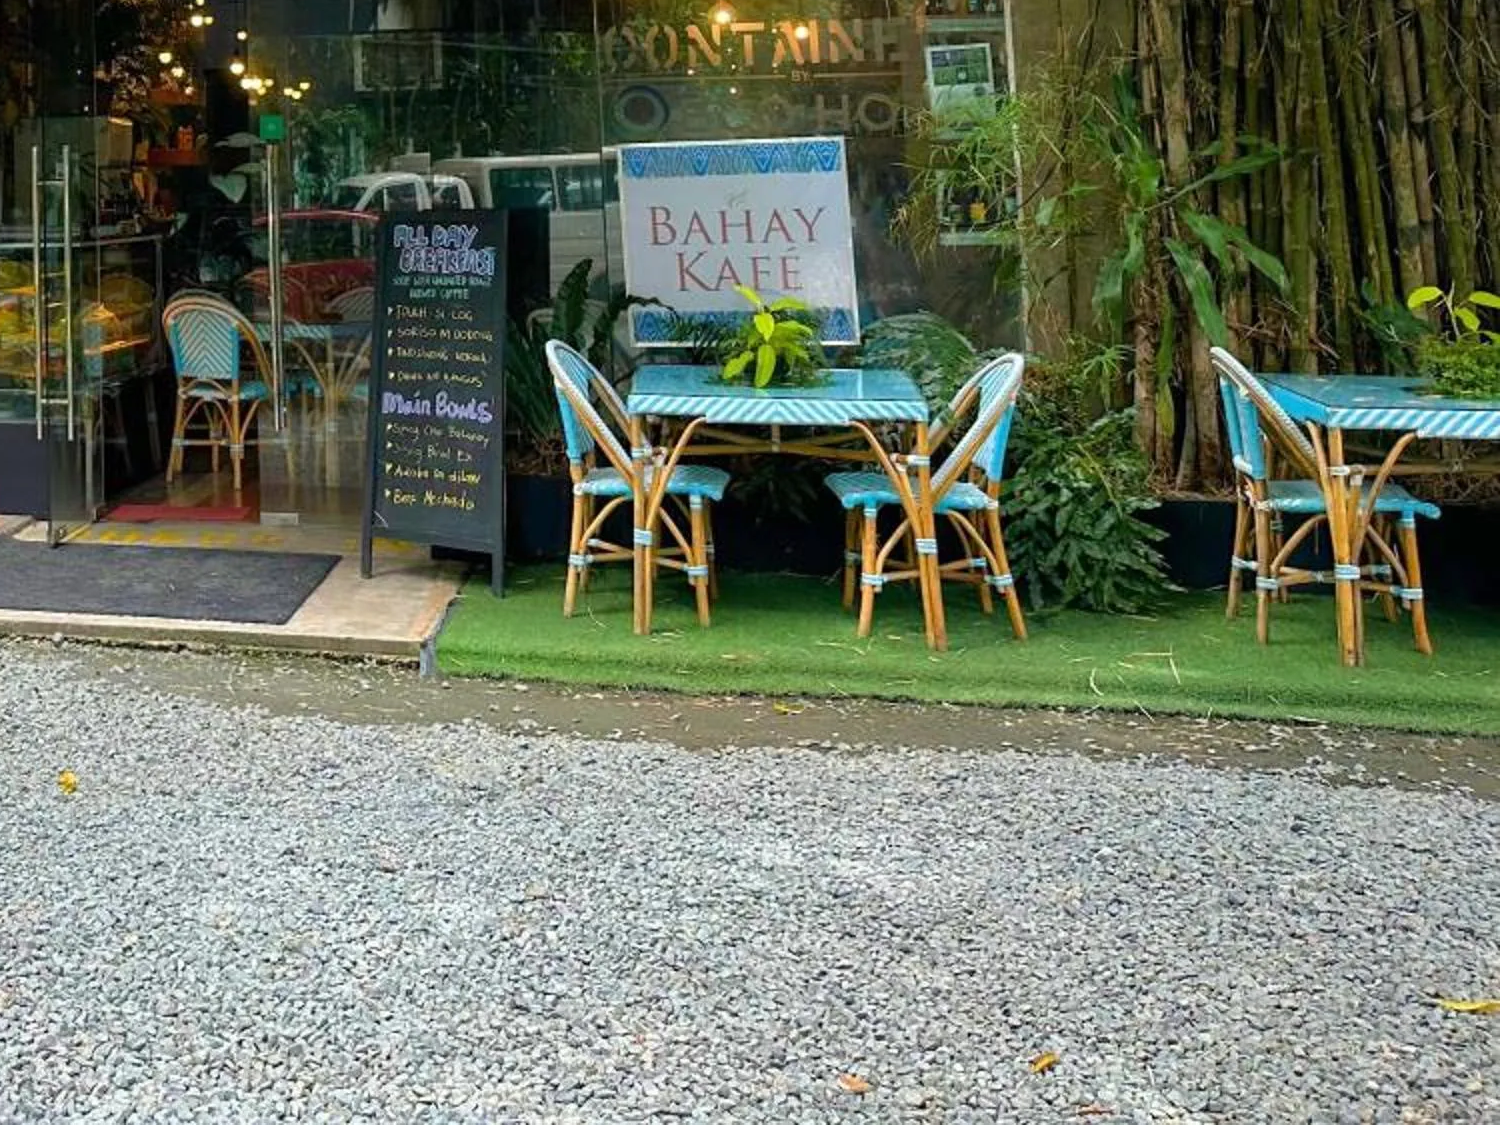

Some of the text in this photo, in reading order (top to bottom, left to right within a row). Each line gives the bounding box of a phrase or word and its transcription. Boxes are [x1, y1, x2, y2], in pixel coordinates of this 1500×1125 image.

[393, 224, 479, 249] ALL DAY
[647, 205, 828, 247] BAHAY
[675, 246, 805, 294] KAFÉ
[381, 390, 493, 423] Main Bowls
